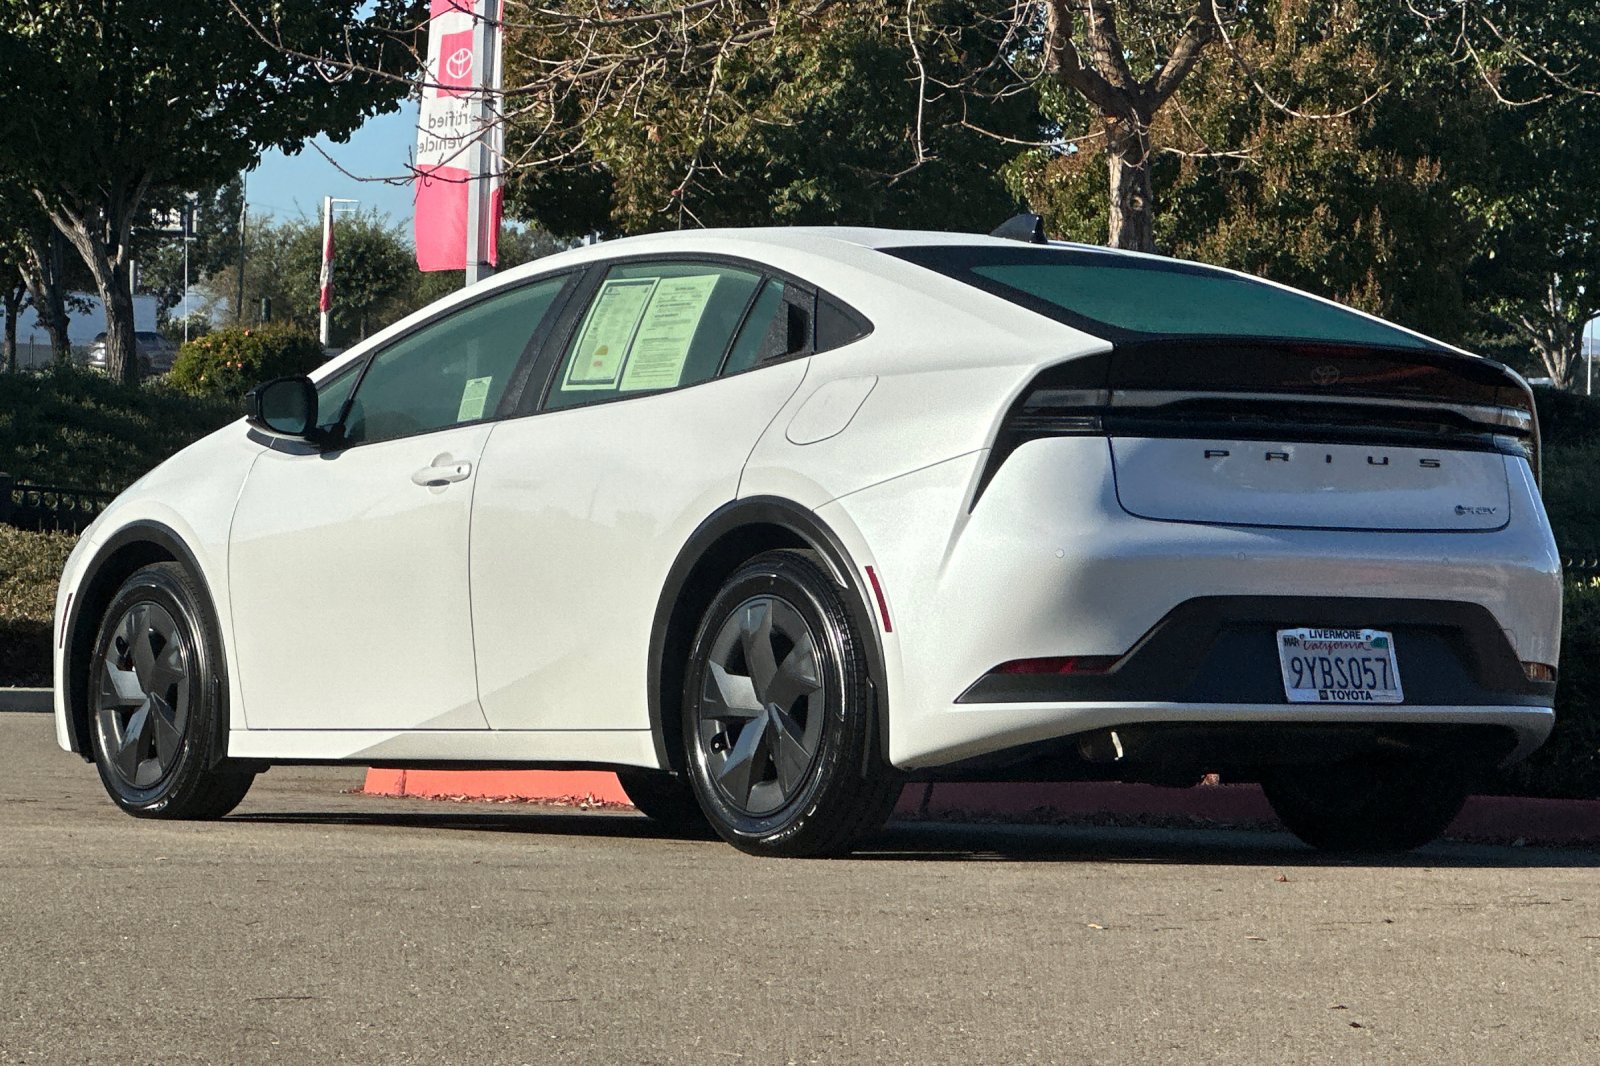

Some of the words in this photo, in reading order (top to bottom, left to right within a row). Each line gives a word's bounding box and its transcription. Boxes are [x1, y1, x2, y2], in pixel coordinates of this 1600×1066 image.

[1204, 449, 1440, 468] PRIUS
[1309, 629, 1361, 640] LIVERMORE
[1303, 641, 1371, 655] California
[1291, 656, 1388, 690] 9YBS057
[1329, 690, 1373, 700] TOYOTA
